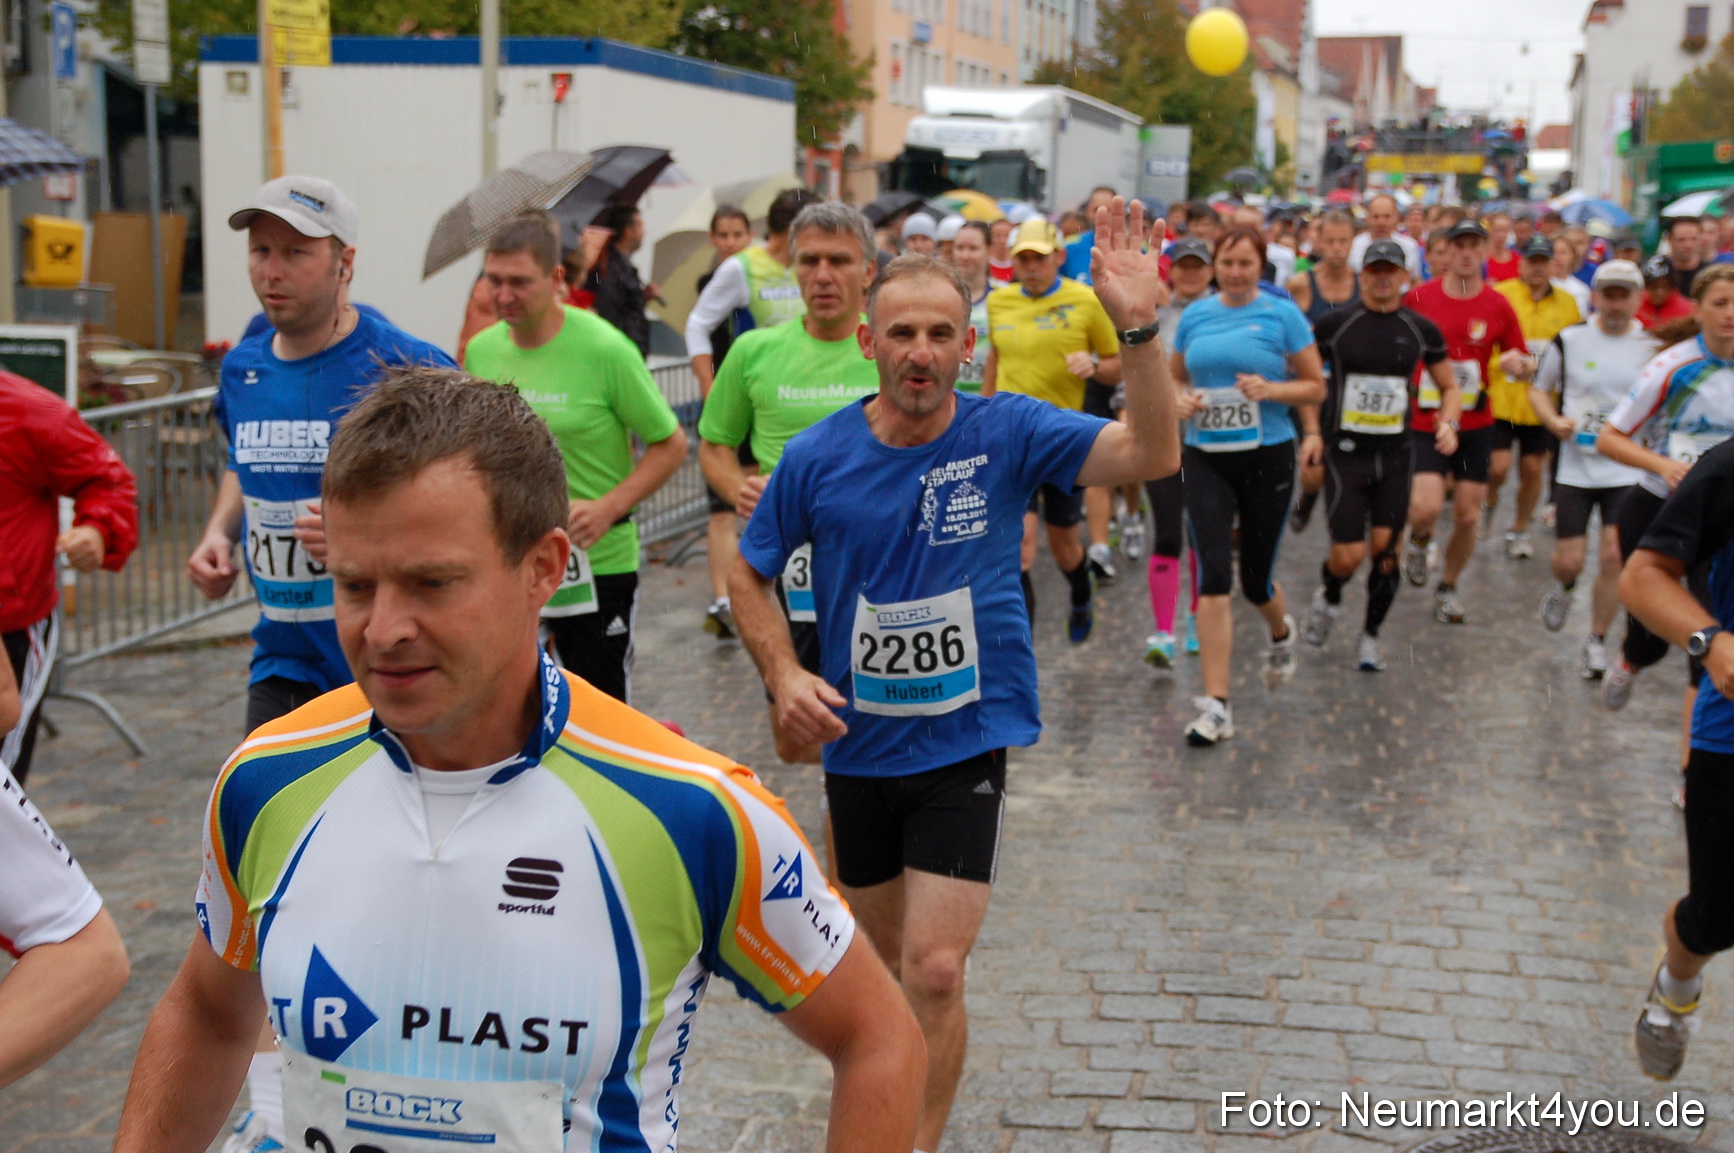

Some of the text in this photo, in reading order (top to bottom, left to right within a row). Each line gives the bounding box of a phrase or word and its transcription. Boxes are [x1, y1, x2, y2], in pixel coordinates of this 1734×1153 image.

[1357, 391, 1395, 412] 387
[1202, 403, 1253, 428] 2826
[235, 420, 331, 449] HUBER
[250, 450, 325, 460] TECHNOLOGY
[945, 508, 987, 522] 18.09.2011
[792, 556, 808, 587] 3
[877, 606, 931, 624] BOCK
[859, 624, 965, 675] 2286
[885, 682, 943, 700] Hubert
[498, 903, 555, 916] sportful
[402, 1004, 589, 1056] PLAST
[346, 1087, 463, 1125] BOCK
